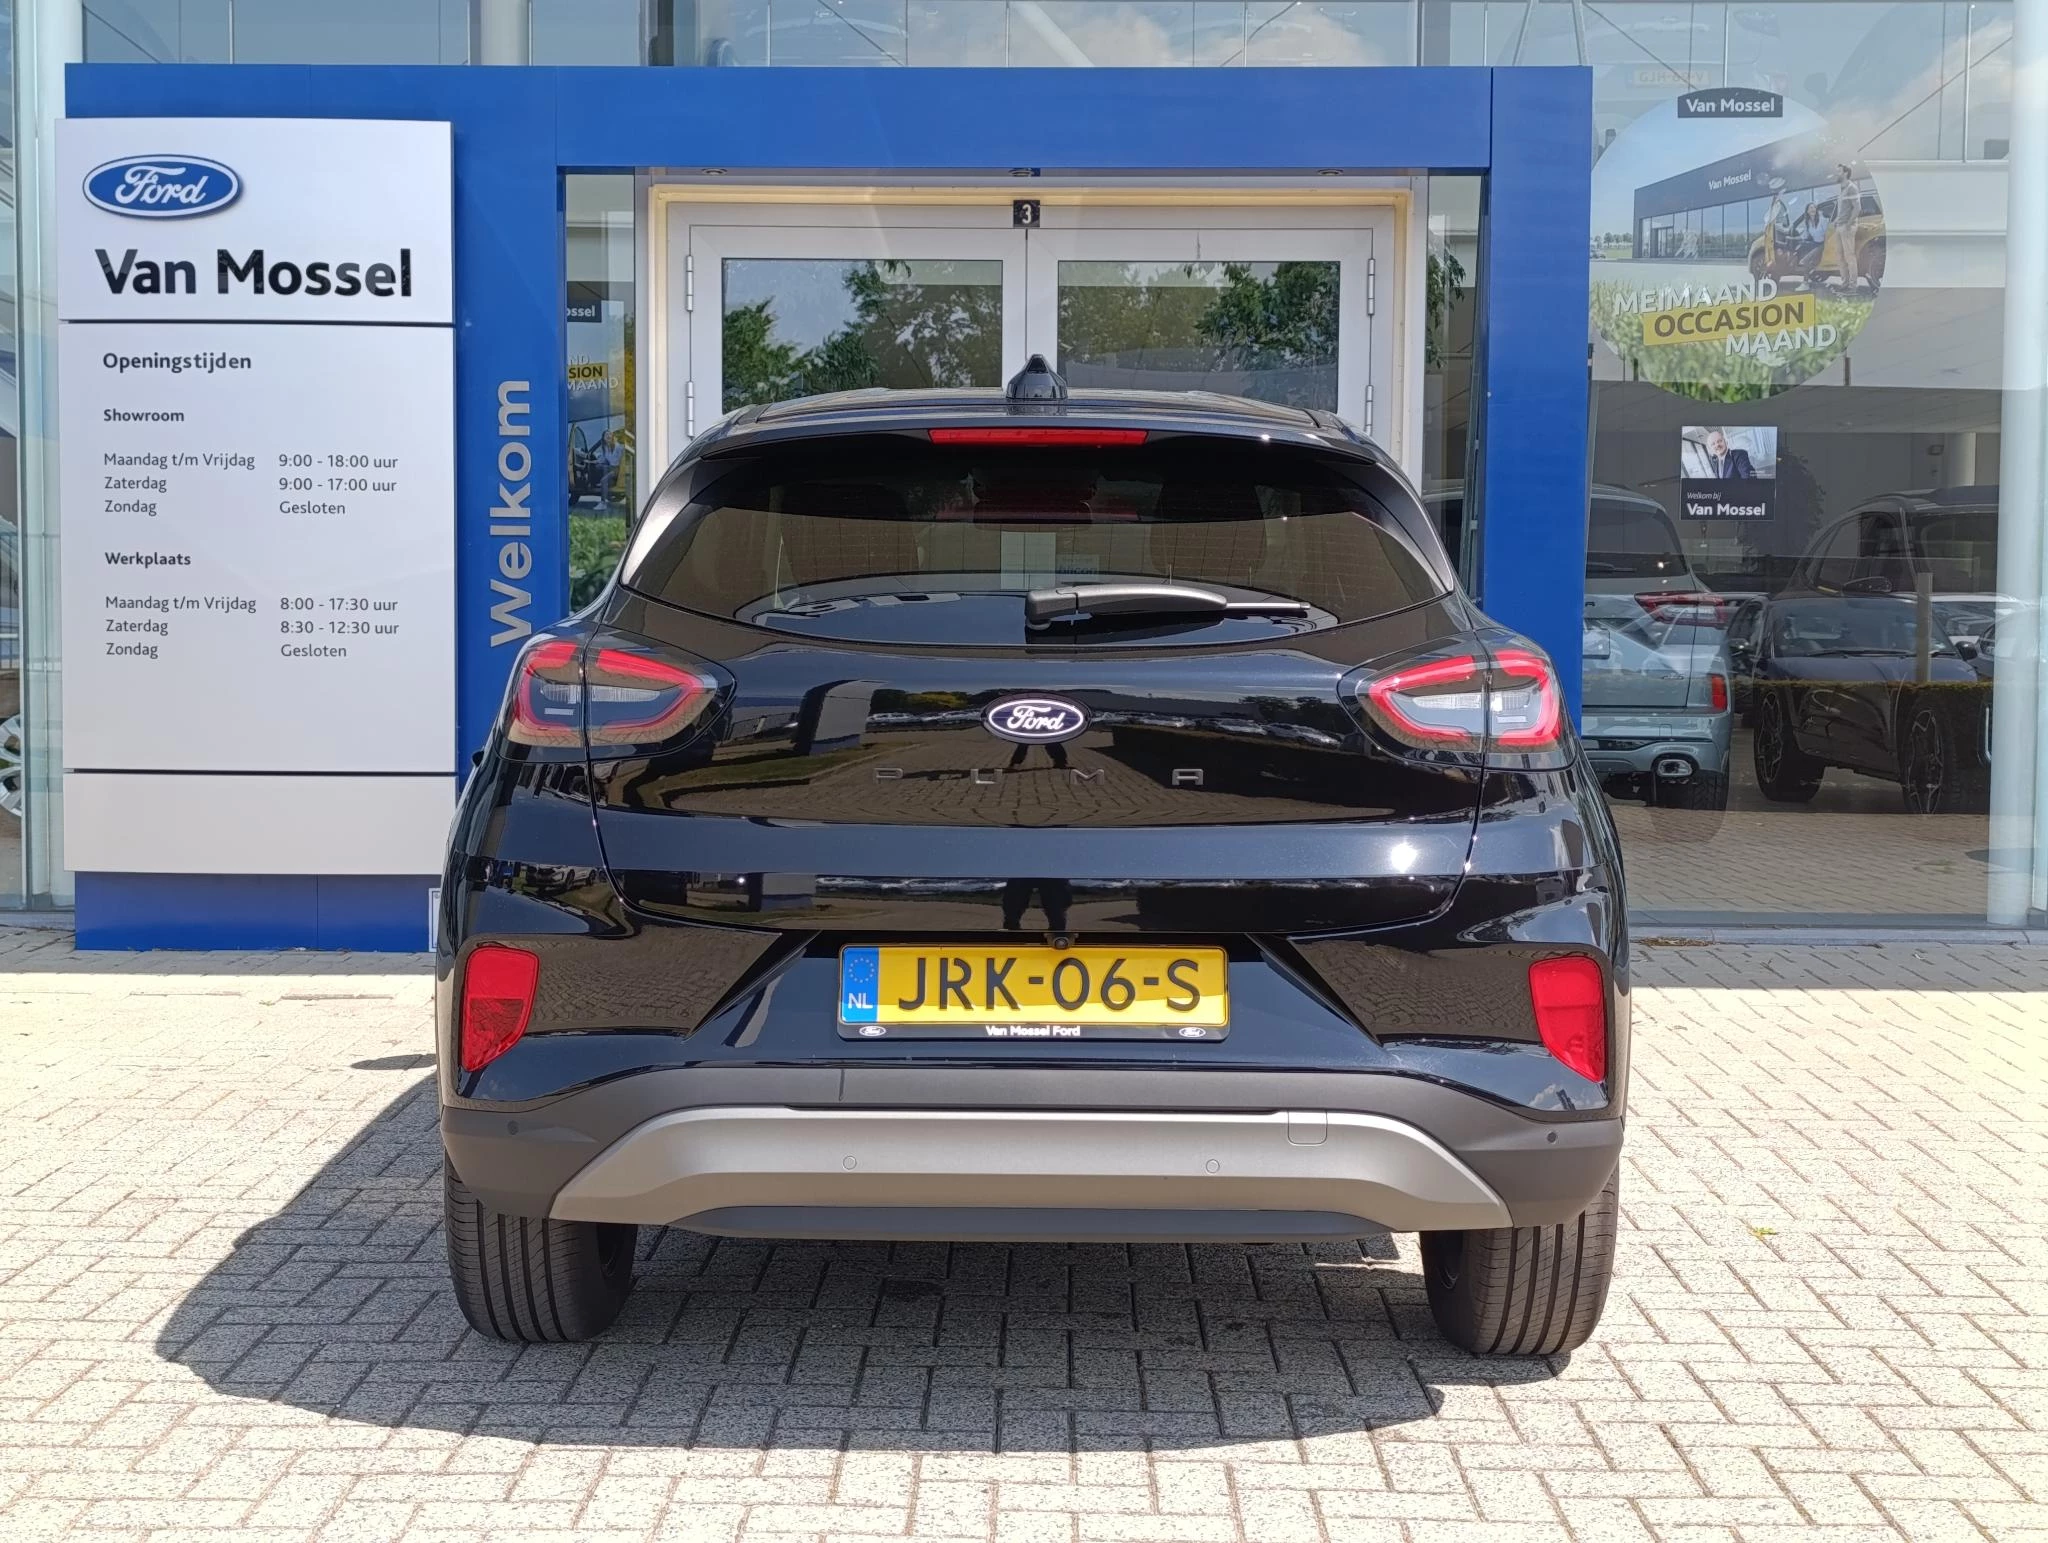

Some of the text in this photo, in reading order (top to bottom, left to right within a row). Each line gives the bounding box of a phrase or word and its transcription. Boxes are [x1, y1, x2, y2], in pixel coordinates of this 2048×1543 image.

[1686, 97, 1775, 112] Van Mossel
[114, 165, 209, 204] Ford
[1708, 169, 1752, 190] Van Mossel
[1022, 204, 1032, 224] 3
[95, 248, 411, 297] Van Mossel
[1614, 278, 1778, 315] MEIMAAND
[567, 305, 596, 317] ssel
[1654, 301, 1804, 337] OCCASION
[1726, 324, 1837, 355] MAAND
[102, 352, 252, 374] Openingstijden
[568, 365, 603, 379] SION
[103, 407, 185, 423] Showroom
[103, 452, 256, 471] Maandag t/m Vrijdag
[279, 453, 313, 468] 9:00
[328, 454, 370, 468] 18:00
[374, 459, 399, 469] uur
[104, 476, 168, 494] Zaterdag
[279, 477, 313, 491] 9:00
[328, 478, 368, 491] 17:00
[373, 482, 398, 492] uur
[1687, 491, 1712, 500] Welkom
[104, 499, 158, 518] Zondag
[279, 500, 346, 515] Gesloten
[489, 380, 532, 647] Welkom
[1687, 502, 1766, 516] Van Mossel
[105, 552, 192, 570] Werkplaats
[105, 596, 257, 614] Maandag t/m Vrijdag
[280, 597, 314, 611] 8:00
[329, 597, 370, 611] 17:30
[374, 601, 399, 611] uur
[105, 619, 169, 637] Zaterdag
[281, 620, 314, 634] 8:30
[329, 621, 371, 634] 12:30
[375, 625, 400, 635] uur
[105, 642, 159, 660] Zondag
[280, 643, 347, 658] Gesloten
[1006, 705, 1064, 731] Ford
[873, 768, 1204, 786] PUMA
[898, 957, 1201, 1012] JRK-06-S
[848, 993, 873, 1009] NL
[985, 1025, 1081, 1037] Van Mossel Ford
